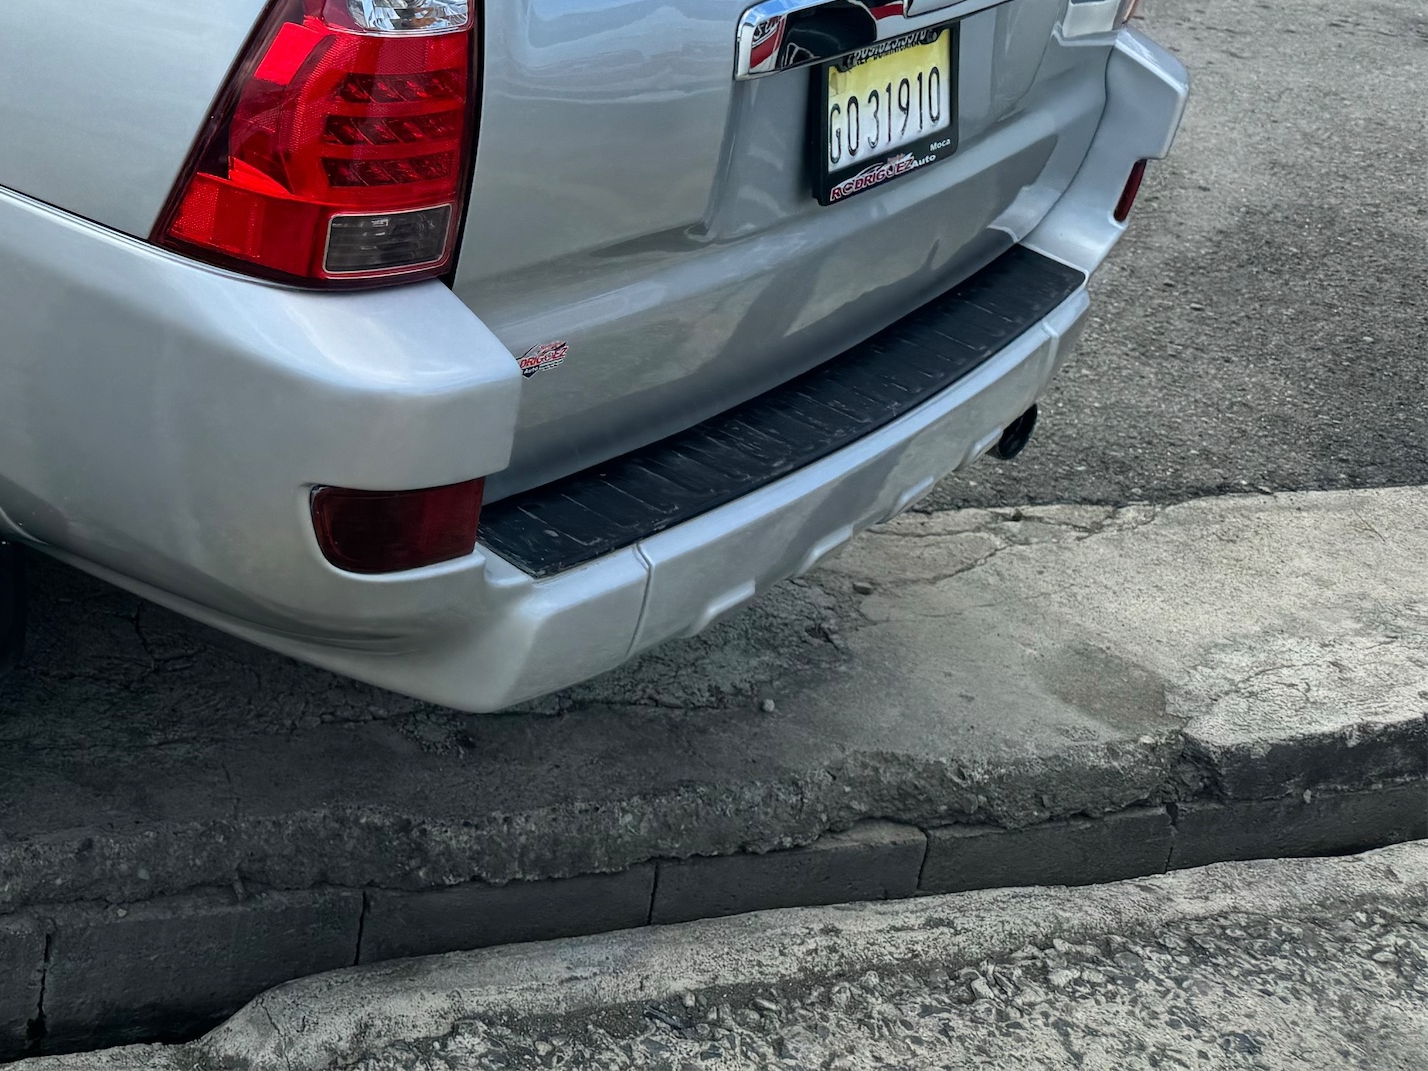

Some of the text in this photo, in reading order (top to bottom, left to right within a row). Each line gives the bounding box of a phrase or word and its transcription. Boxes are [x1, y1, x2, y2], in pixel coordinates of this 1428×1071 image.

[829, 66, 941, 164] G031910
[929, 138, 951, 152] Moca
[912, 153, 937, 168] Auto
